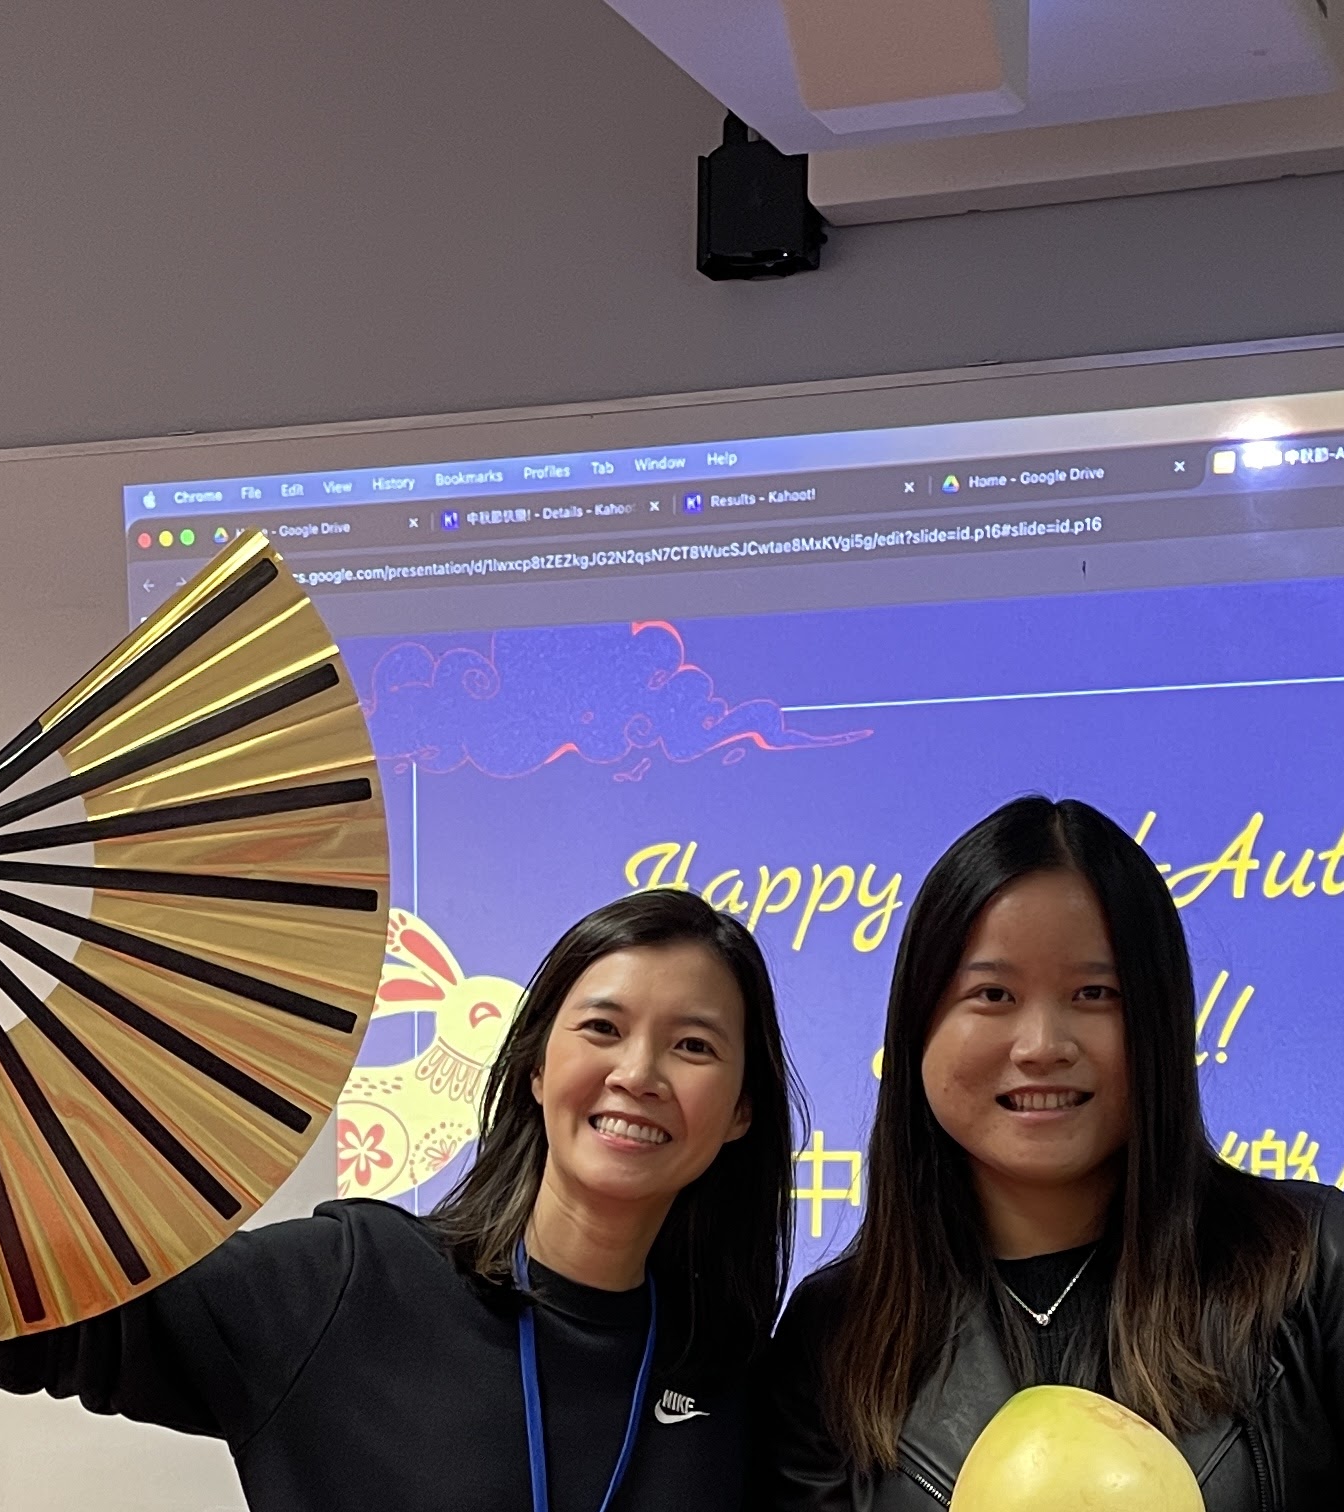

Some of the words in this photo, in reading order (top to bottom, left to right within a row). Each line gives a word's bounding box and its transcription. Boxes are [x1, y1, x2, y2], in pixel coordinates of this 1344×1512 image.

[174, 490, 223, 505] Chrome
[241, 486, 262, 500] File
[281, 483, 304, 498] Edit
[323, 480, 353, 494] View
[372, 476, 416, 492] History
[435, 470, 504, 487] Bookmarks
[523, 464, 571, 481] Profiles
[592, 461, 615, 475] Tab
[634, 456, 686, 472] Window
[707, 452, 738, 468] Help
[968, 474, 1007, 489] Home
[1020, 470, 1067, 486] Google
[1069, 467, 1105, 481] Drive
[710, 494, 756, 508] Results
[768, 488, 816, 503] Kahoot!
[542, 506, 583, 520] Details
[279, 524, 318, 538] Google
[321, 522, 351, 534] Drive
[624, 840, 904, 953] Happy
[662, 1388, 696, 1415] NIKE
